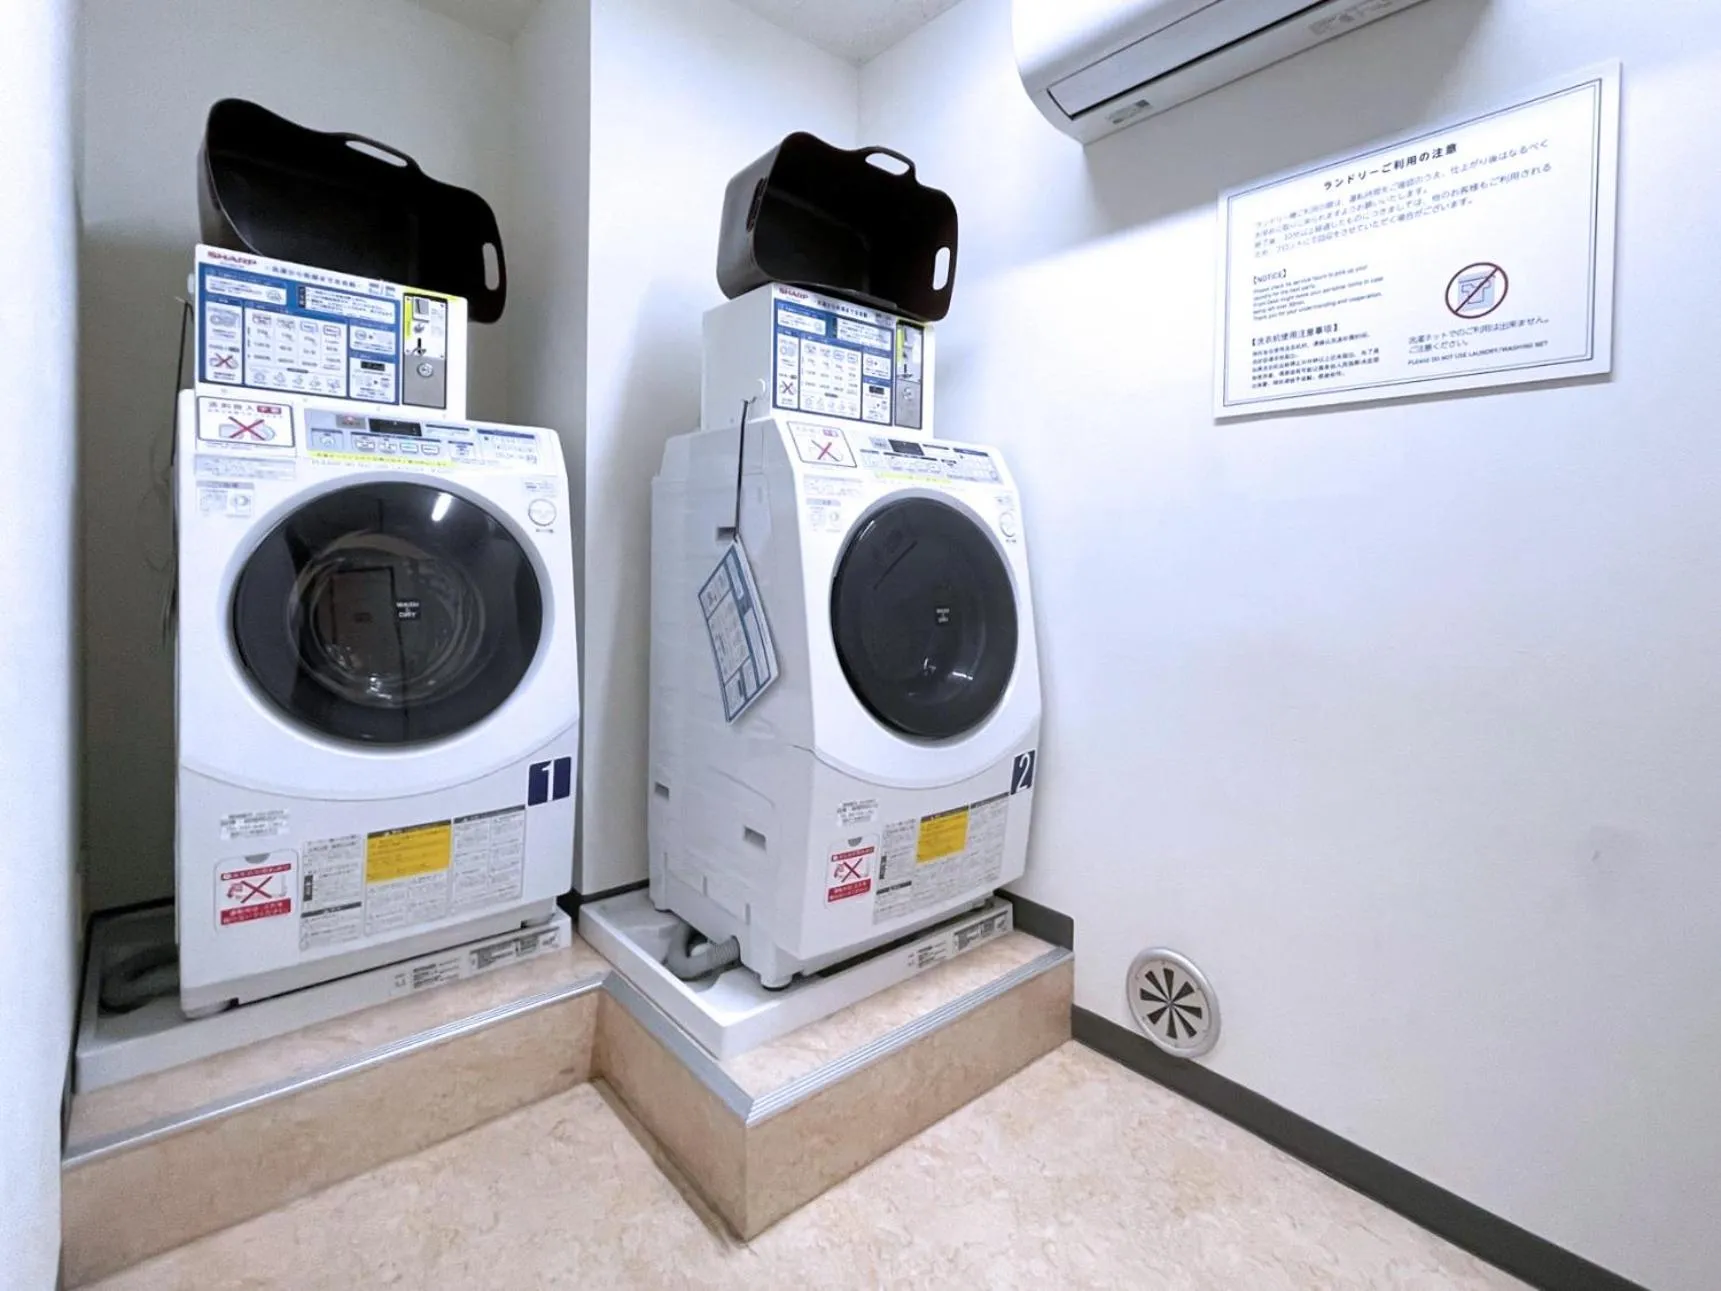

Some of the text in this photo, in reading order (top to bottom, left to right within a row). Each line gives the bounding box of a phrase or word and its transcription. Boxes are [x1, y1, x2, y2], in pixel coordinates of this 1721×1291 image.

[1323, 141, 1457, 192] ランドリーご利用の注意
[541, 759, 555, 801] 1
[1016, 753, 1031, 791] 2
